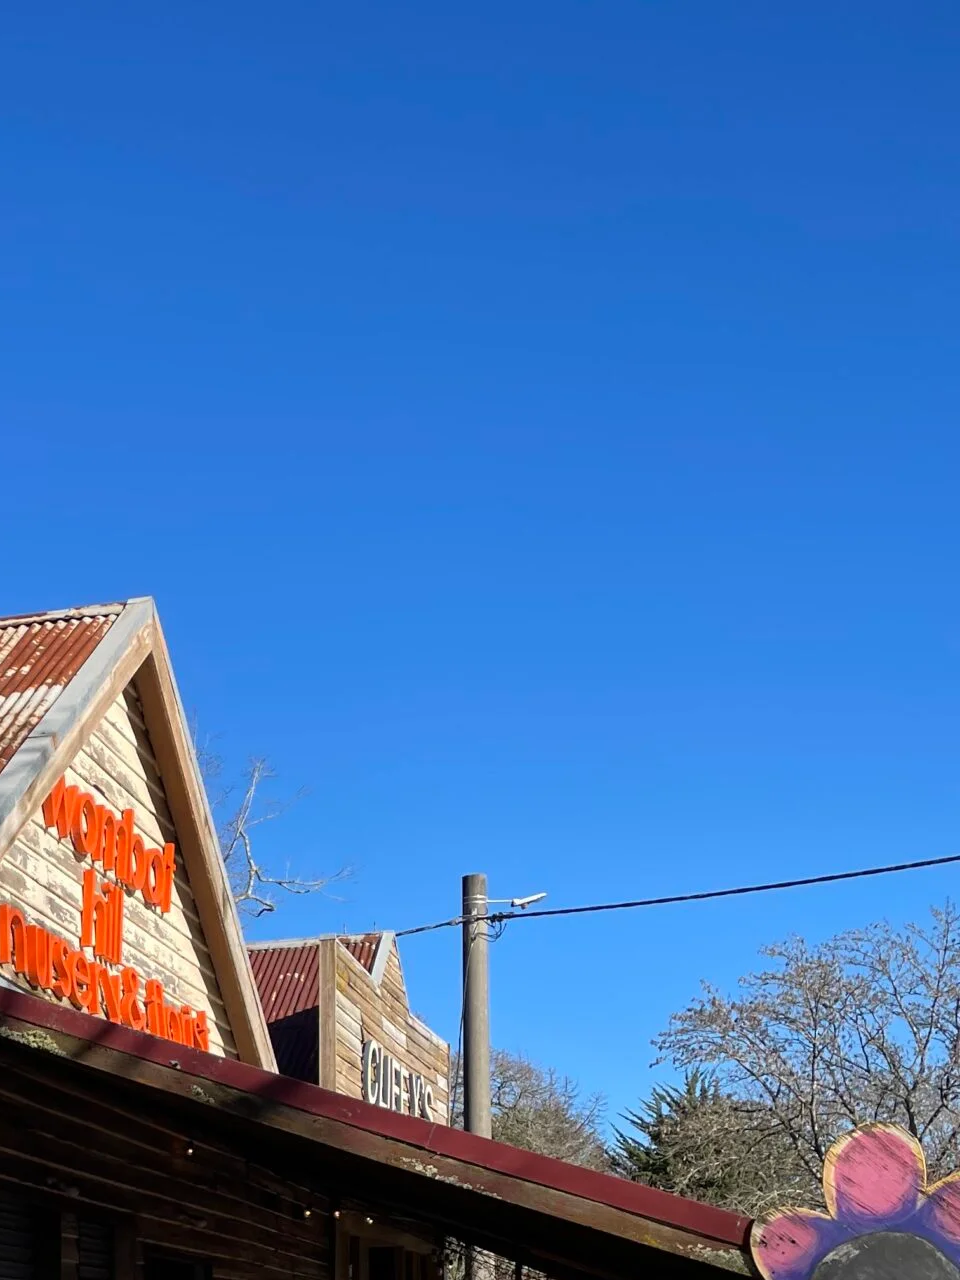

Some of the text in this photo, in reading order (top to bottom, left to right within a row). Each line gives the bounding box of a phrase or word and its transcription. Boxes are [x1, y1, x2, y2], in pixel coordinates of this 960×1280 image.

[42, 773, 176, 913] wombat
[81, 869, 124, 964] hill
[120, 967, 146, 1031] &
[363, 1039, 435, 1122] CLIFFY'S
